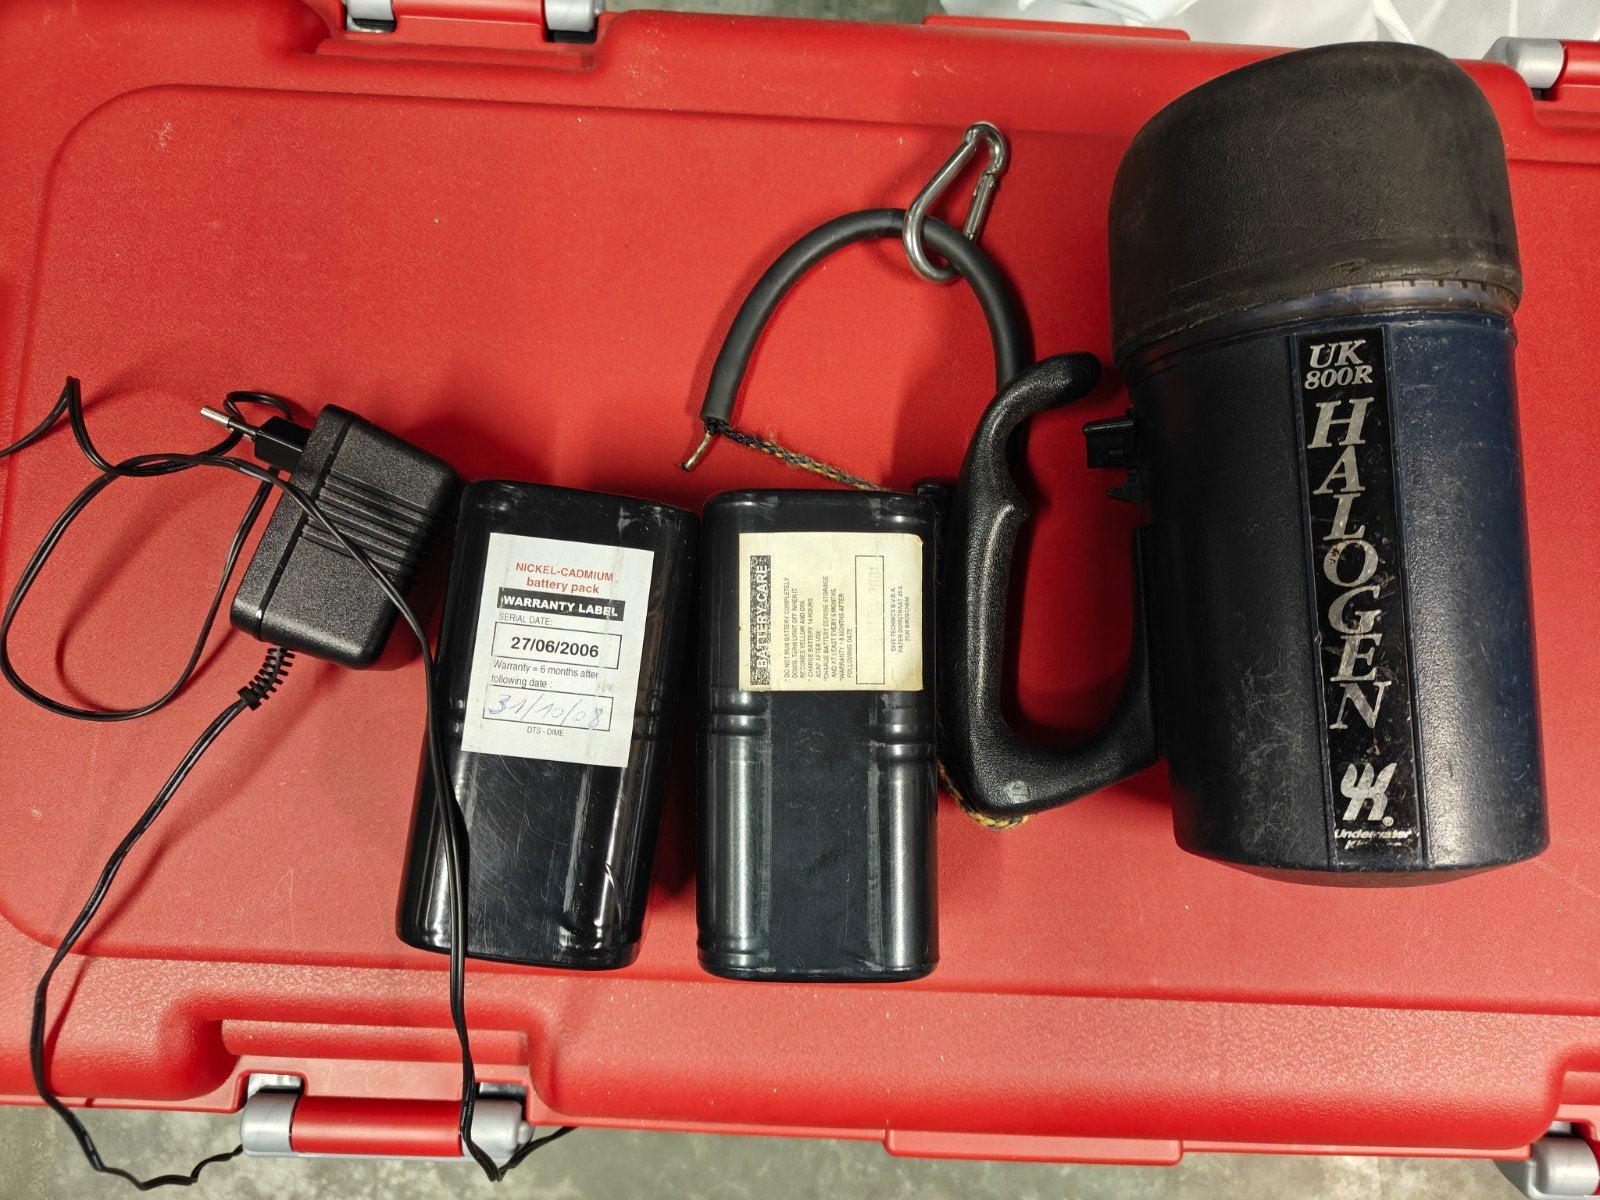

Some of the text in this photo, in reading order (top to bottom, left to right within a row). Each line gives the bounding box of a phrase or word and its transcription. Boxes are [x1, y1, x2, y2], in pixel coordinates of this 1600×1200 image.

[1310, 339, 1366, 369] UK
[1304, 364, 1374, 390] 800R
[515, 562, 614, 581] NICKEL-CADMIUM
[1307, 396, 1392, 730] HALOGEN
[526, 577, 600, 594] battery pack
[503, 595, 618, 617] WARRANTY LABEL
[756, 565, 767, 668] BATTERY CARE
[499, 612, 553, 626] SERIAL DATE:
[510, 636, 599, 658] 27/06/2006
[493, 660, 531, 673] Warranty
[540, 665, 546, 674] 6
[548, 667, 578, 678] months
[580, 669, 599, 679] after
[491, 675, 527, 688] following
[529, 678, 547, 688] date
